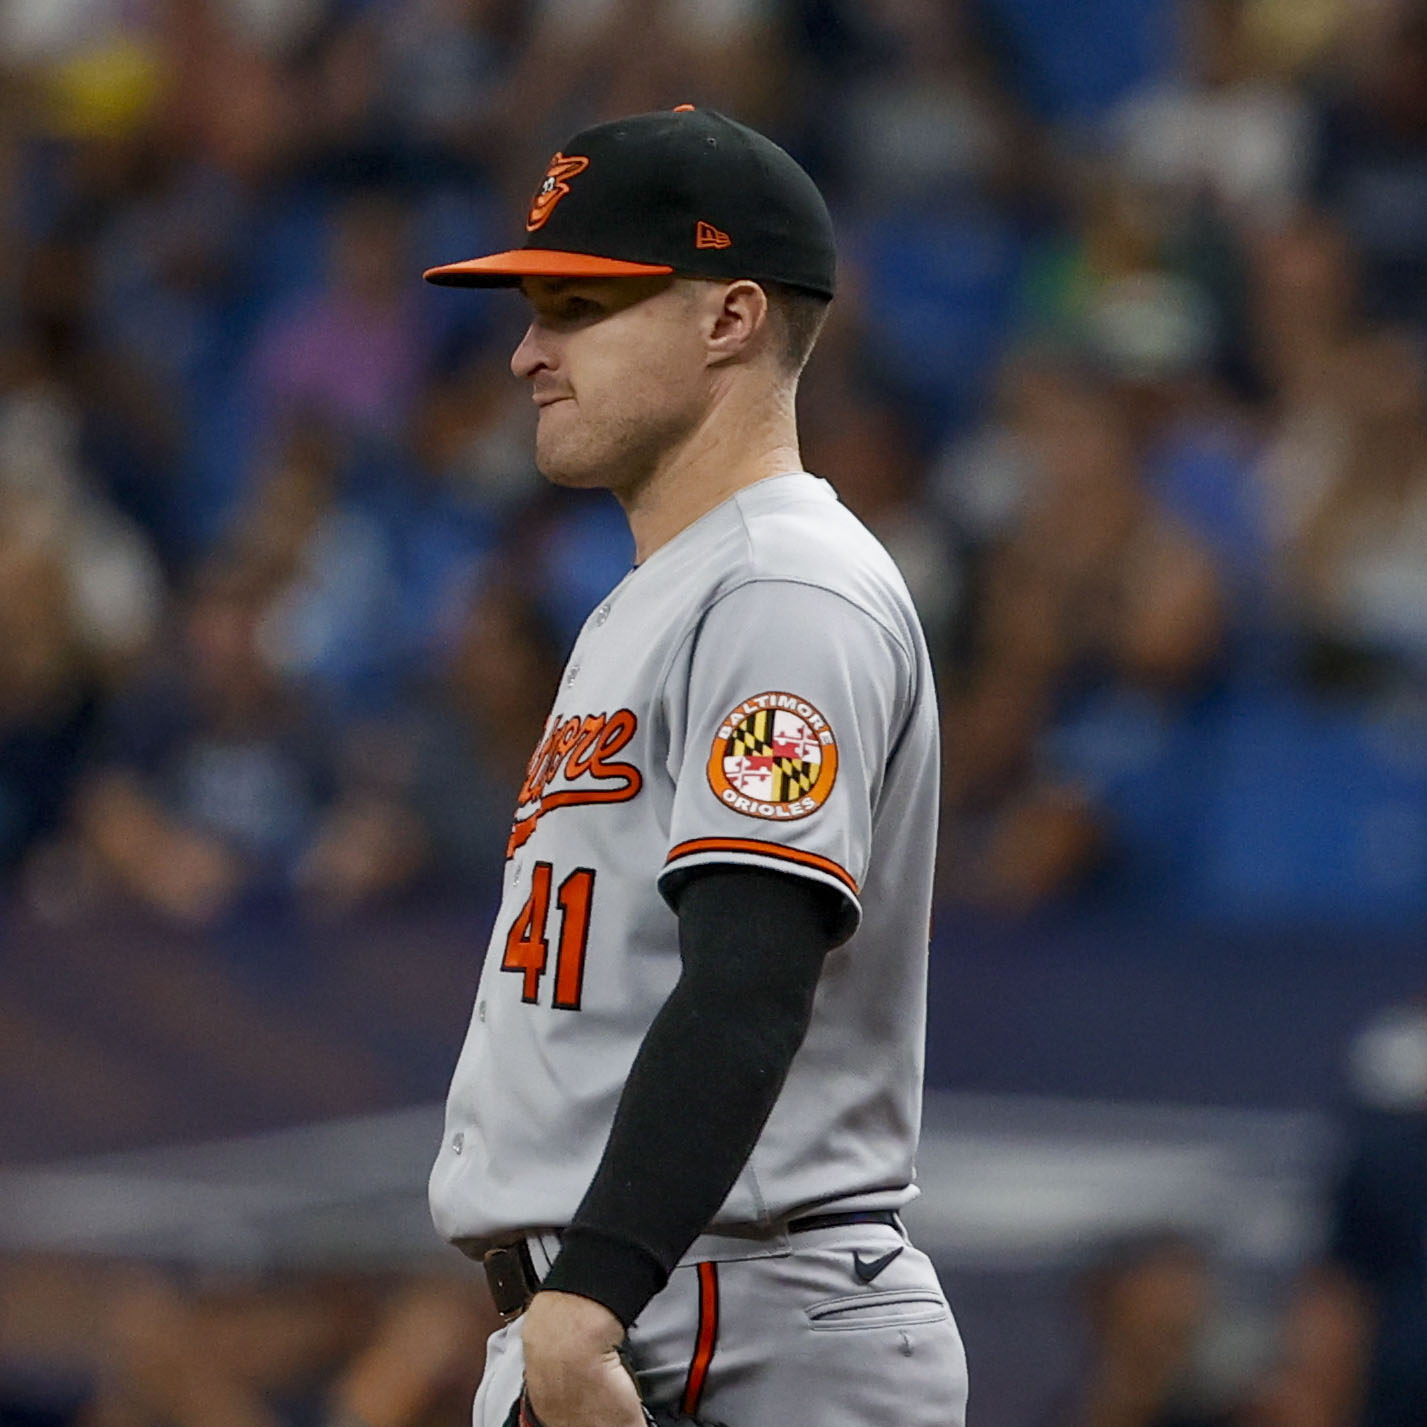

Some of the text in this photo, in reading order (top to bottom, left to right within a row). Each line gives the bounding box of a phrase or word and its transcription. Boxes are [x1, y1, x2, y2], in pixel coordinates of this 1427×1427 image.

[718, 694, 834, 746] BALTIMORE
[722, 789, 816, 817] ORIOLES
[501, 861, 596, 1011] 41
